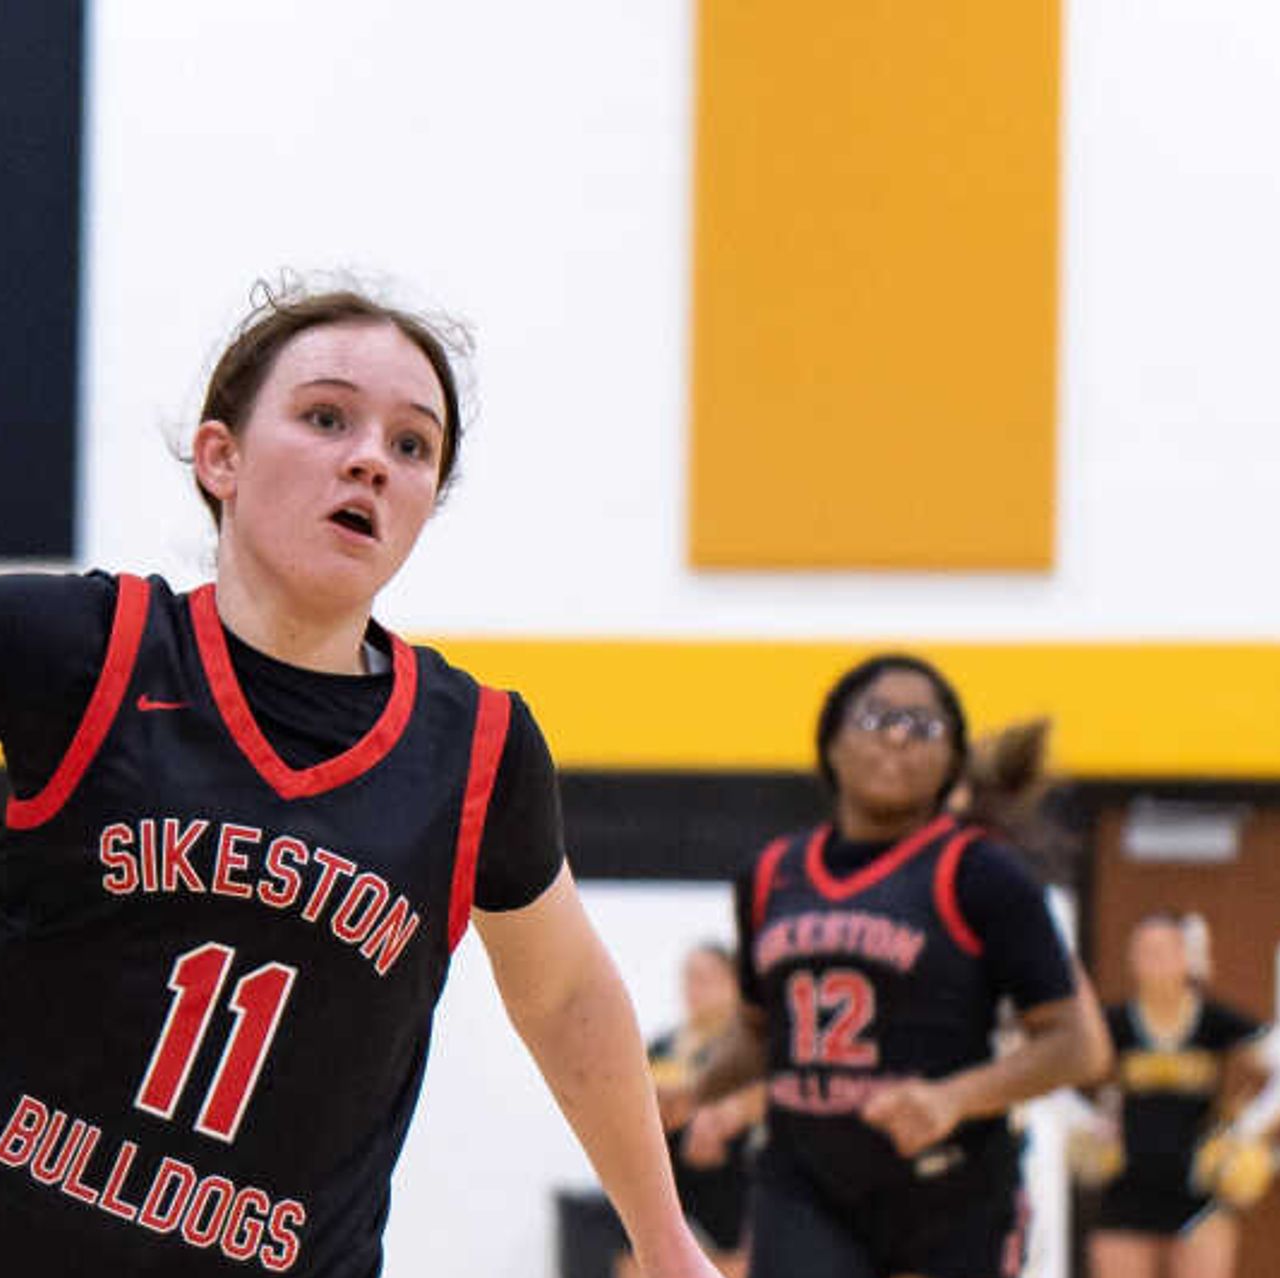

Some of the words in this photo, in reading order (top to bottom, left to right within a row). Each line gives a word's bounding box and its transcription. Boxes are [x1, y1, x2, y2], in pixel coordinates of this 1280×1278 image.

[98, 816, 422, 977] SIKESTON
[133, 940, 299, 1145] 11
[787, 969, 879, 1067] 12
